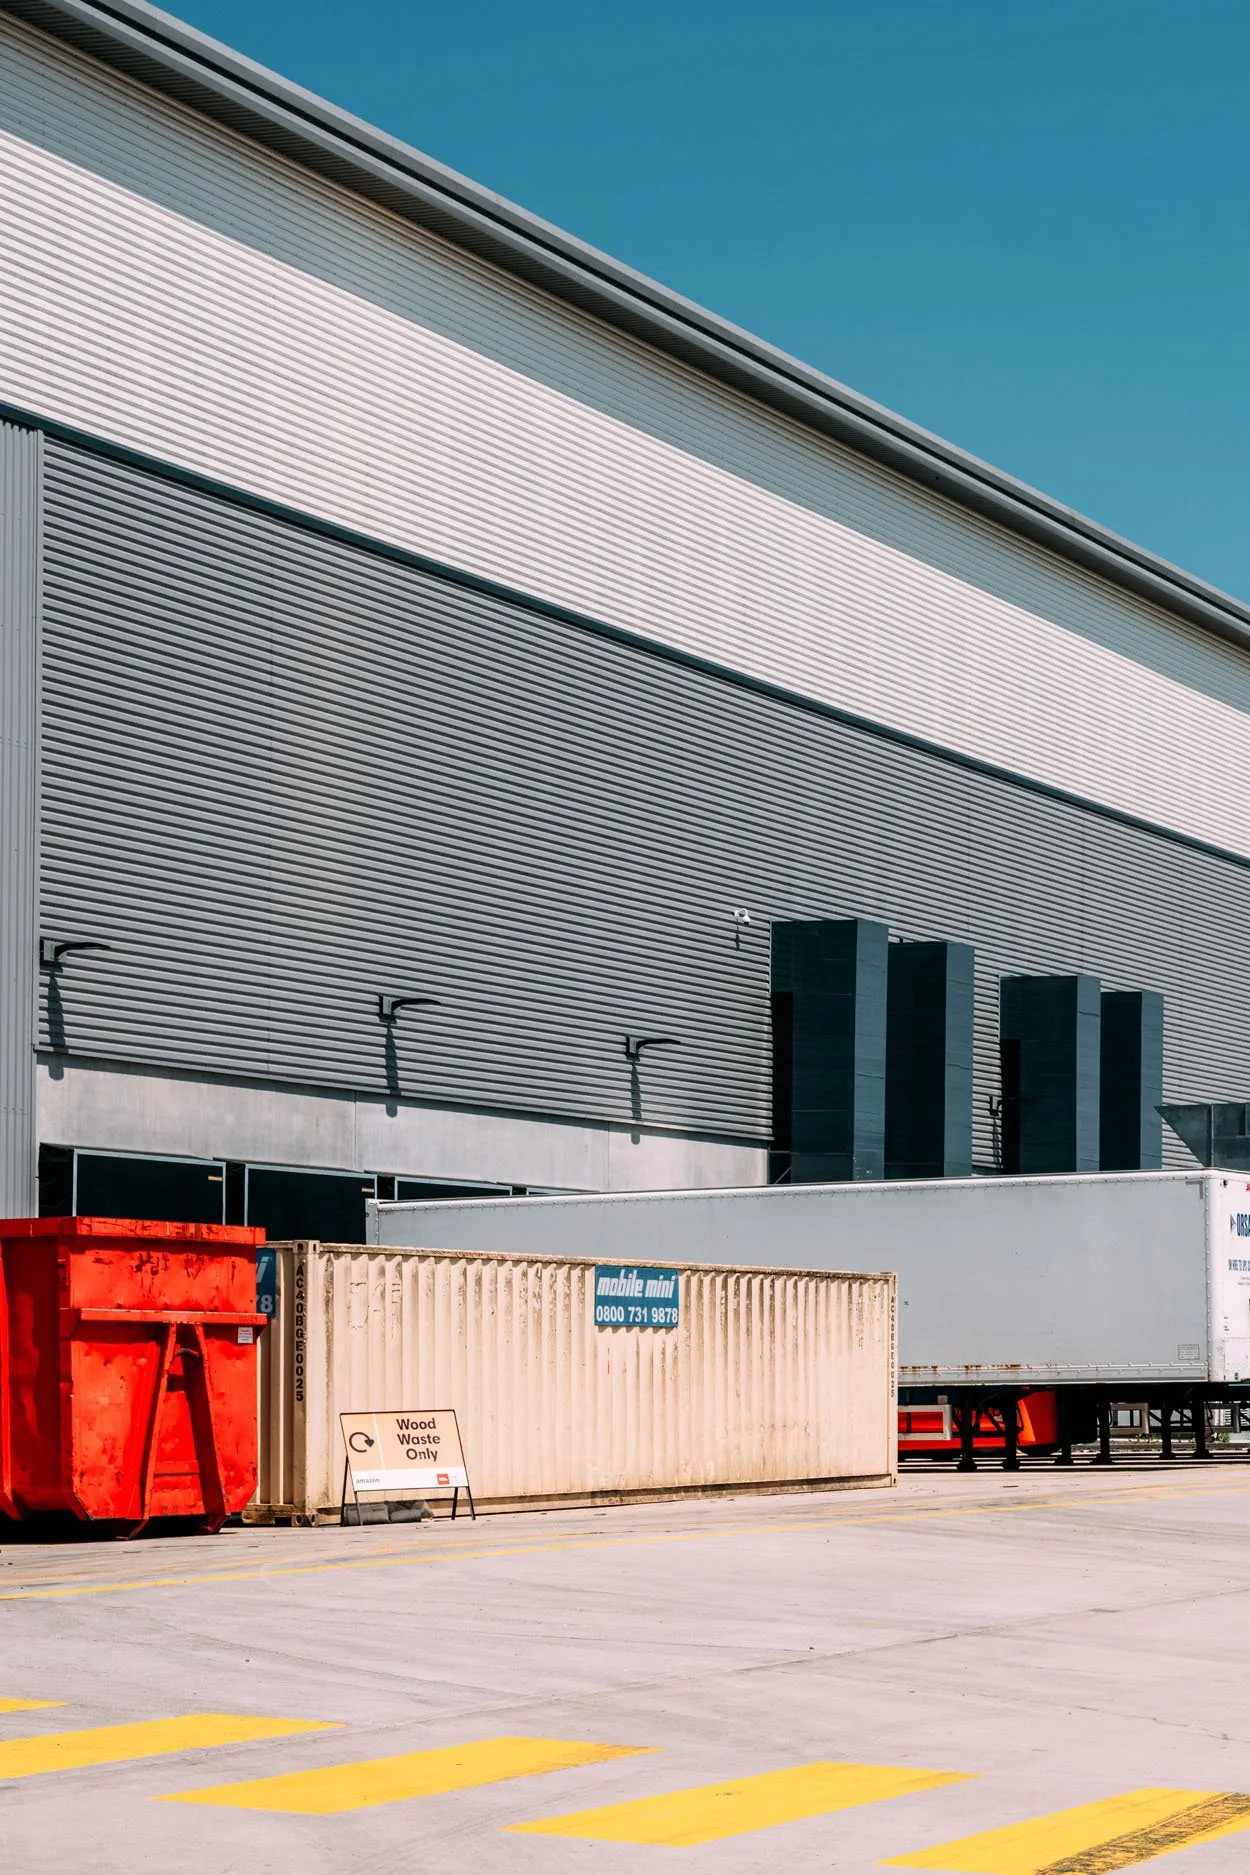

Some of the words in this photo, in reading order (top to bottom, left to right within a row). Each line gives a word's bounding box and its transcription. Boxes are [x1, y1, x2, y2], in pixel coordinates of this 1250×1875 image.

[596, 1269, 644, 1297] mobile
[644, 1275, 676, 1298] mini
[596, 1305, 625, 1322] 0800
[628, 1306, 648, 1323] 731
[651, 1307, 678, 1323] 9878
[295, 1264, 304, 1402] AC40BGE0025
[396, 1418, 436, 1430] Wood
[397, 1433, 441, 1445] Waste
[406, 1448, 438, 1462] Only
